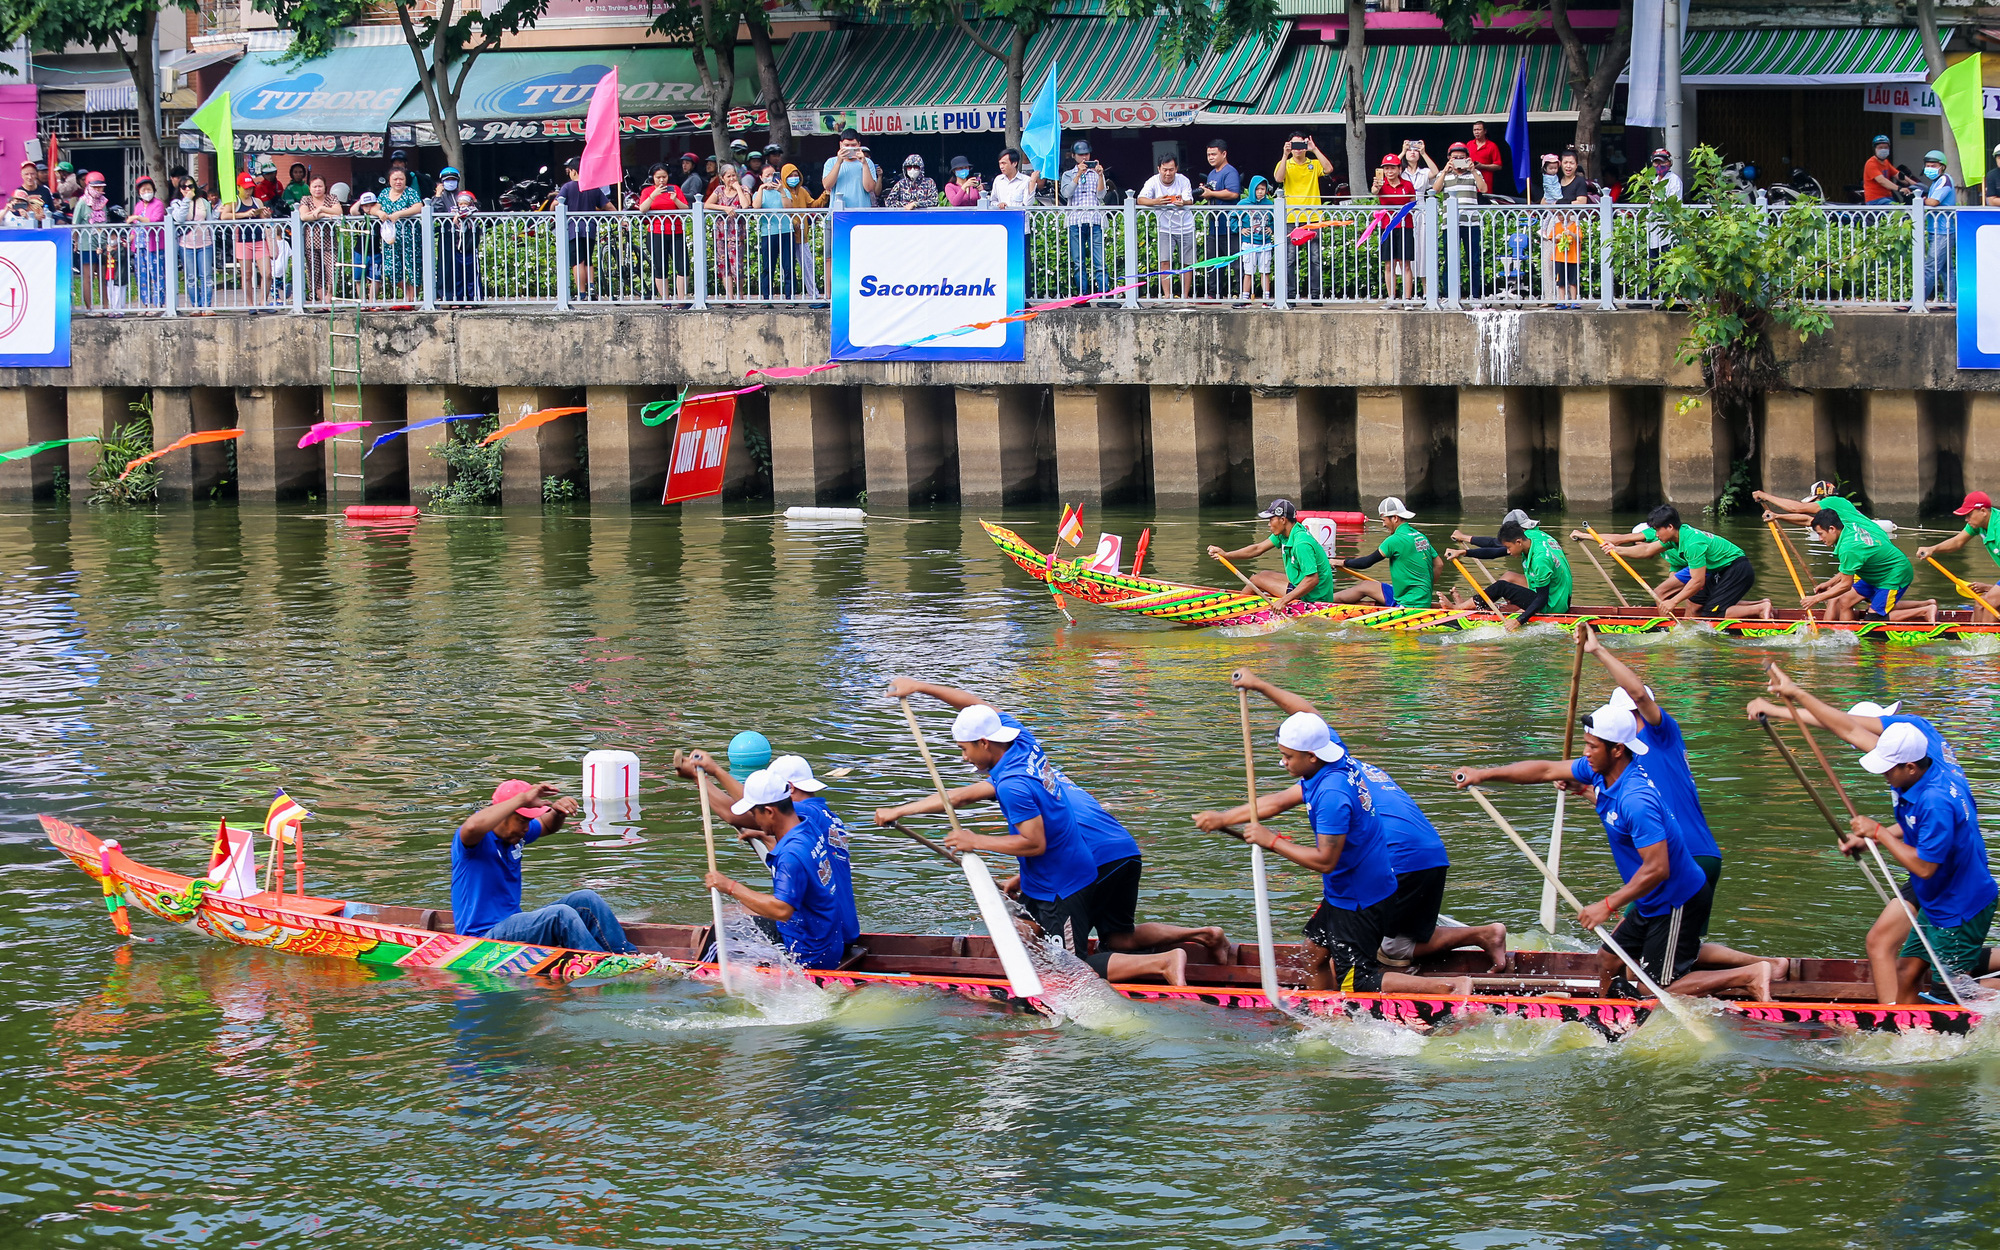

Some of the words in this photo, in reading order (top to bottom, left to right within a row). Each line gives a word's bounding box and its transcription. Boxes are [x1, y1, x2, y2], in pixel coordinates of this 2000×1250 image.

[250, 87, 402, 111] TUBORG
[517, 81, 719, 107] TUOR
[1894, 87, 1909, 106] GÀ
[483, 121, 540, 141] Phê
[685, 107, 770, 131] VỆT
[861, 109, 883, 132] LẨU
[887, 112, 903, 132] GÀ
[914, 111, 929, 131] LÁ
[932, 110, 939, 130] É
[943, 108, 981, 130] PHÚ
[243, 134, 272, 152] Phê
[341, 132, 383, 155] VIỆT
[858, 274, 997, 297] Sacombank
[1091, 535, 1120, 573] 2
[589, 763, 597, 798] 1
[621, 764, 630, 798] 1
